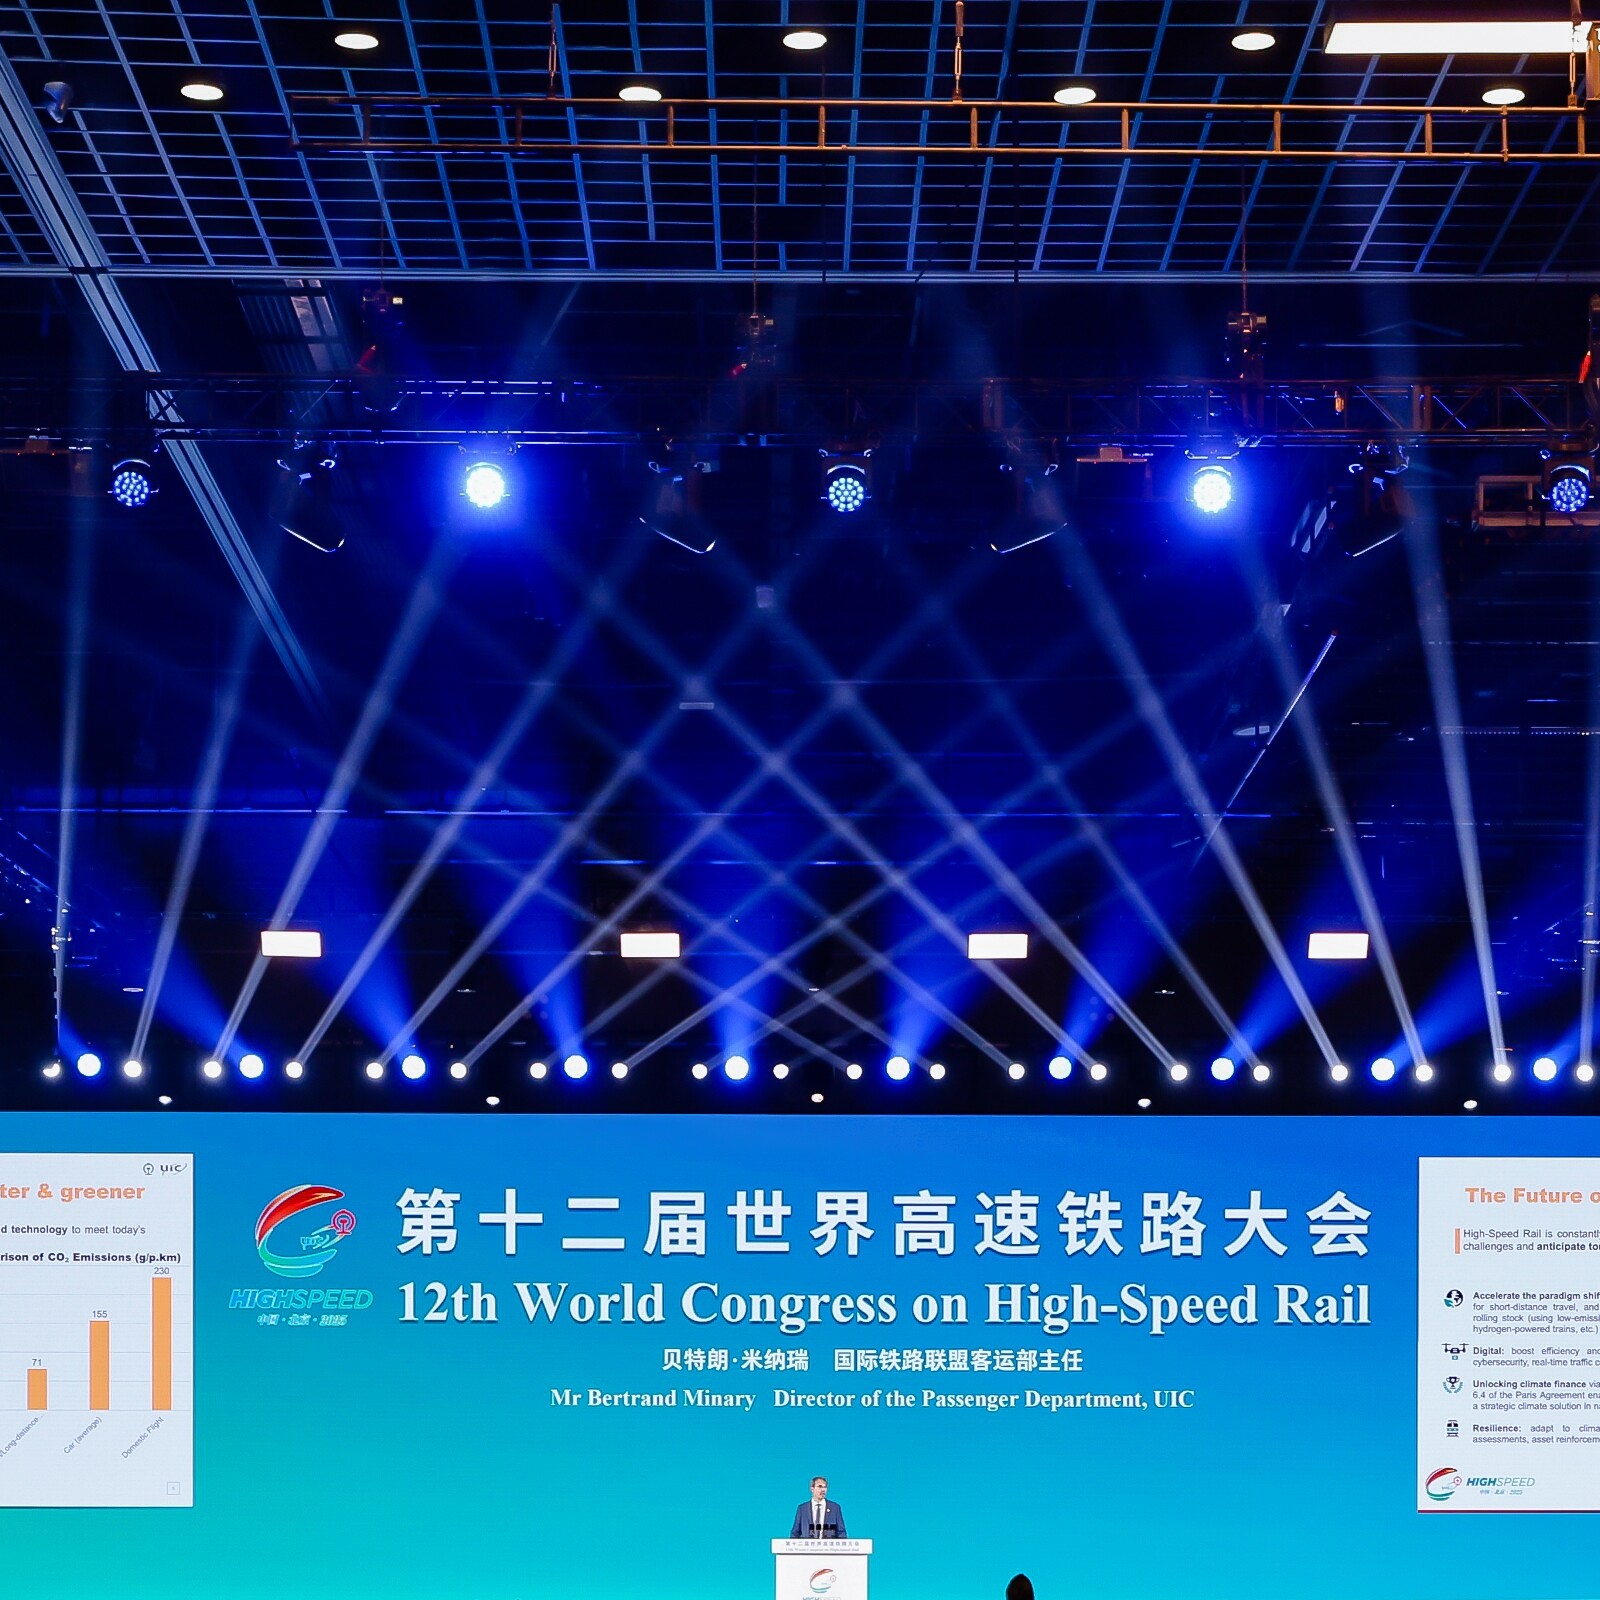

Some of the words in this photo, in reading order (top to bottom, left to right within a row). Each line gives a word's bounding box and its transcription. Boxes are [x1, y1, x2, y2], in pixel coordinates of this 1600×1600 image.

[37, 1183, 53, 1199] &
[60, 1187, 146, 1203] greener
[1465, 1187, 1506, 1203] The
[1514, 1187, 1583, 1203] Future
[396, 1187, 1372, 1256] 第十二届世界高速铁路大会
[11, 1225, 68, 1236] technology
[71, 1226, 81, 1234] to
[84, 1225, 109, 1234] meet
[1463, 1229, 1519, 1240] High-Speed
[1523, 1229, 1541, 1238] Rail
[1545, 1229, 1553, 1238] is
[1463, 1242, 1514, 1253] challenges
[1516, 1242, 1534, 1251] and
[1536, 1242, 1586, 1253] anticipate
[32, 1252, 44, 1261] of
[73, 1252, 132, 1262] Emissions
[135, 1253, 181, 1264] (g/p.km)
[153, 1266, 171, 1275] 230
[228, 1289, 374, 1310] HIGHSPEED
[399, 1281, 498, 1321] 12th
[513, 1282, 666, 1322] World
[681, 1282, 897, 1334] Congress
[913, 1294, 969, 1323] on
[984, 1283, 1259, 1334] High-Speed
[1273, 1284, 1371, 1323] Rail
[91, 1310, 109, 1318] 155
[31, 1358, 42, 1366] 71
[662, 1348, 809, 1371] 贝特朗·米纳瑞
[834, 1348, 1083, 1372] 国际铁路联盟客运部主任
[1472, 1380, 1518, 1390] Unlocking
[1520, 1380, 1552, 1388] climate
[1554, 1380, 1587, 1388] finance
[550, 1389, 582, 1406] Mr
[587, 1389, 677, 1407] Bertrand
[683, 1389, 756, 1411] Minary
[773, 1389, 856, 1407] Director
[861, 1389, 882, 1407] of
[885, 1390, 916, 1407] the
[921, 1389, 1020, 1412] Passenger
[1024, 1390, 1148, 1412] Department,
[1153, 1390, 1194, 1408] UIC
[1466, 1477, 1536, 1487] HIGHSPEED
